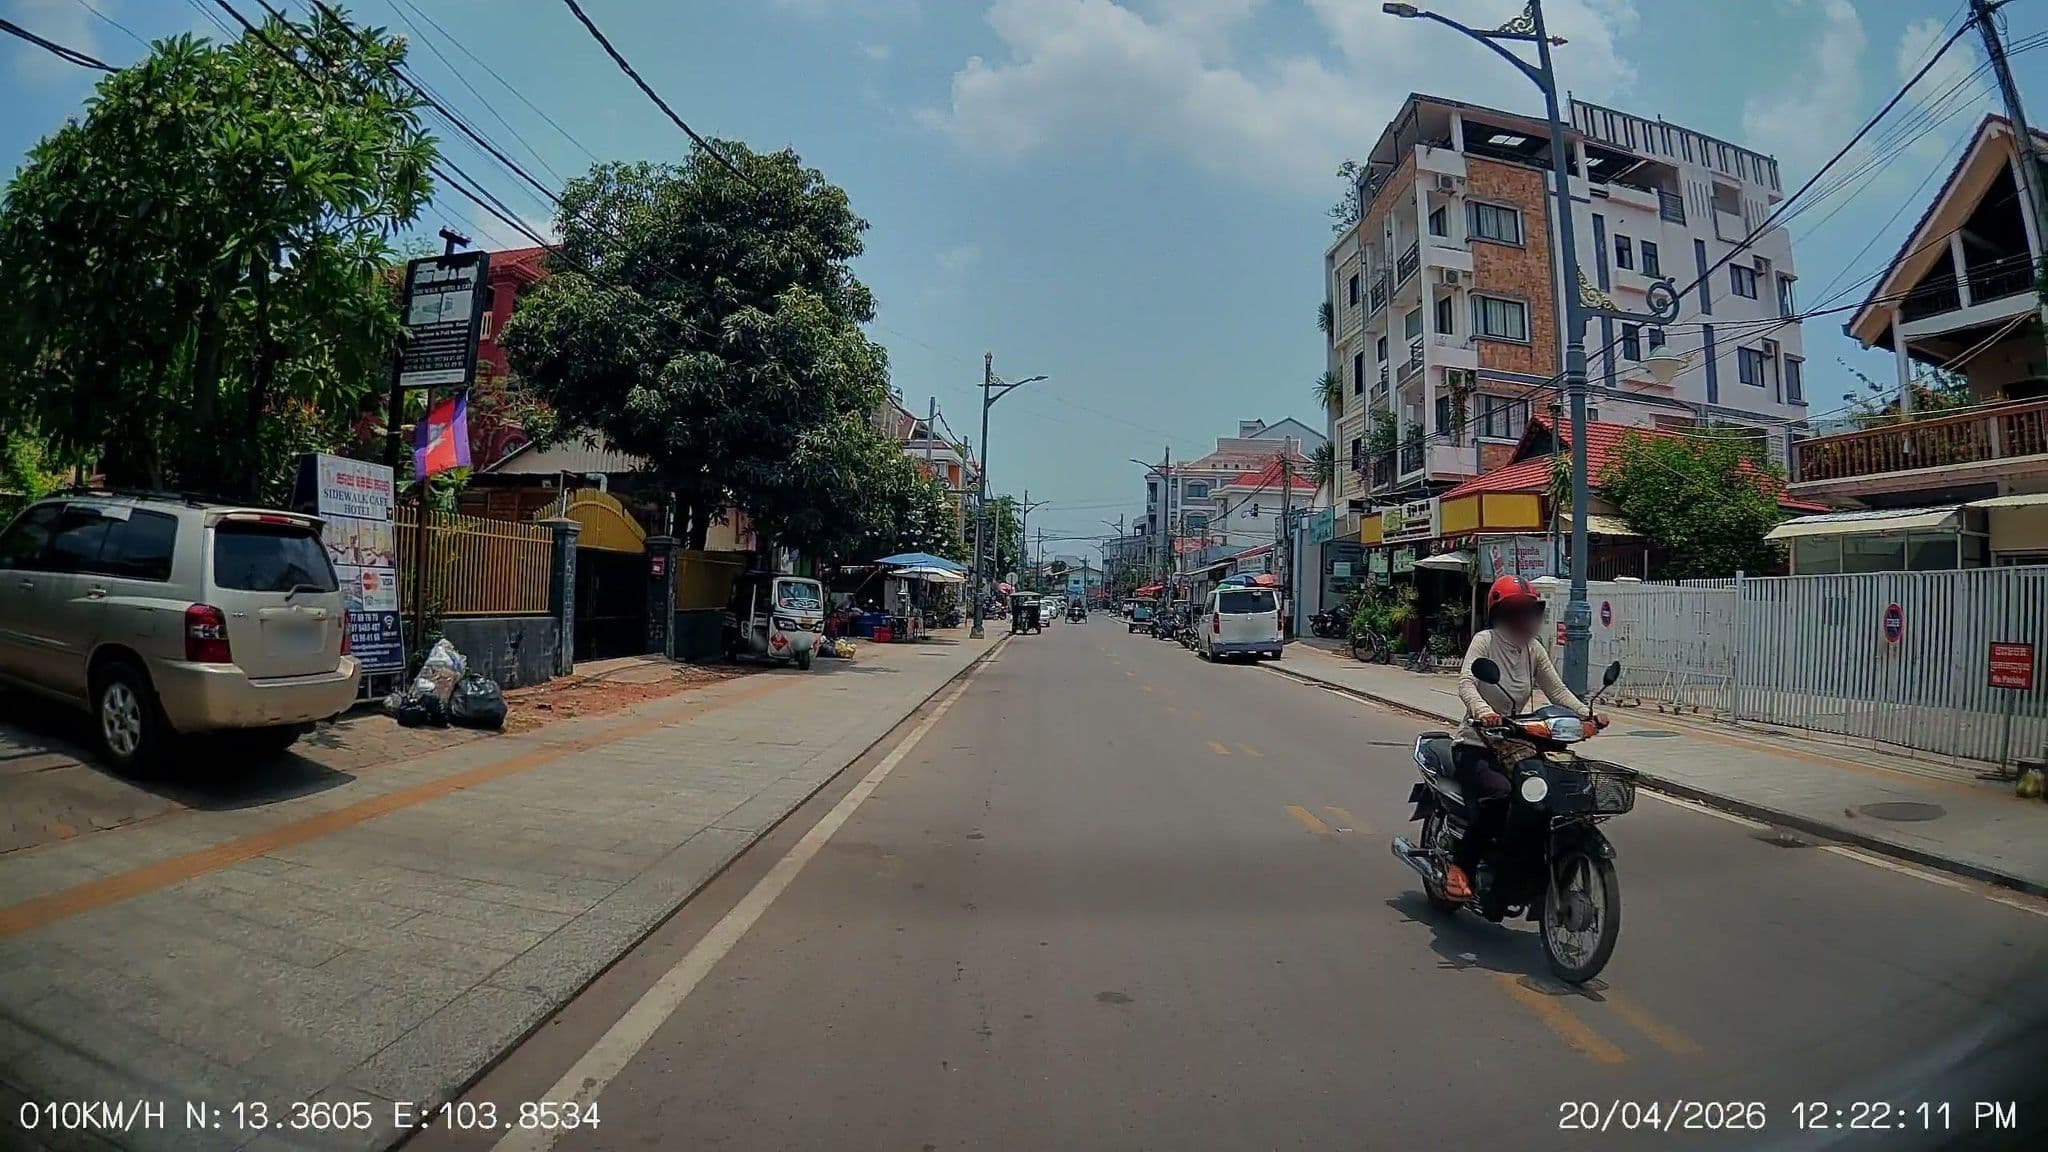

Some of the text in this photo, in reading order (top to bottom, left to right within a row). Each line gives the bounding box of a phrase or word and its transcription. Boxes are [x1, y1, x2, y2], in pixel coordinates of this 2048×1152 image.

[323, 488, 369, 504] SIDEWALK
[344, 504, 370, 516] HOTEL
[2002, 675, 2026, 686] Parking
